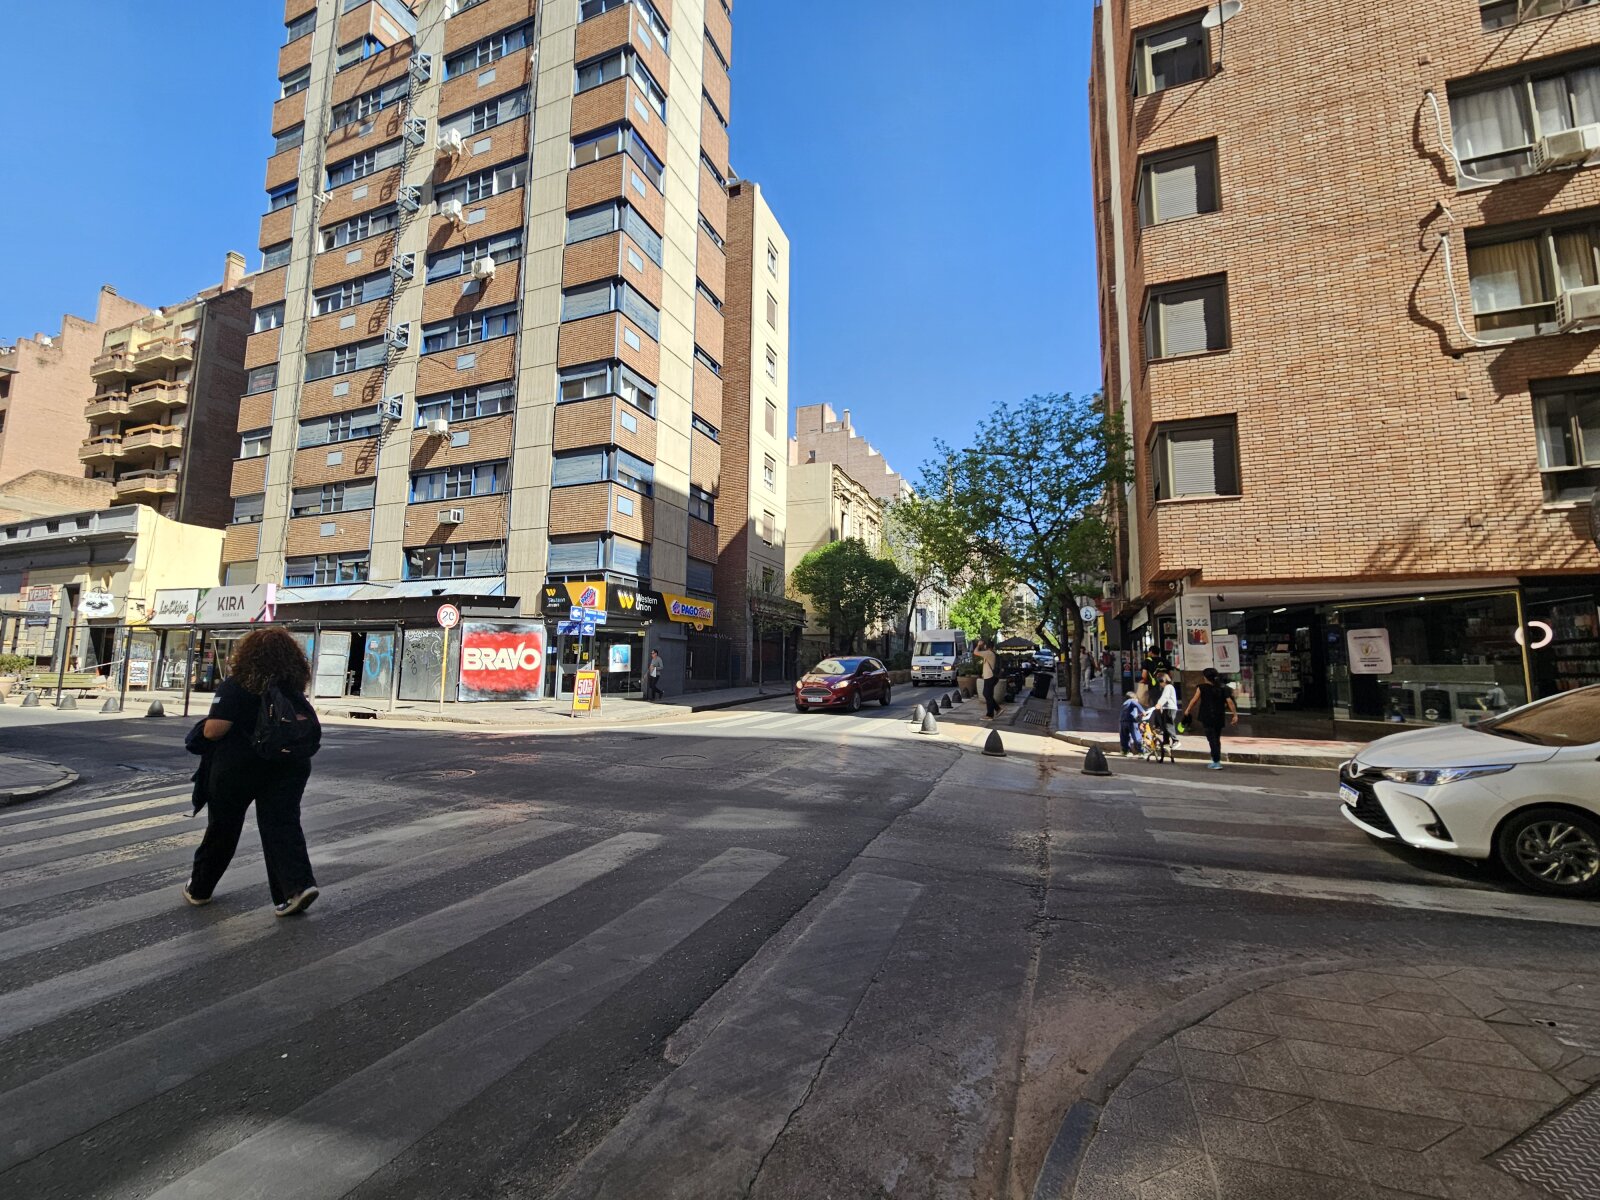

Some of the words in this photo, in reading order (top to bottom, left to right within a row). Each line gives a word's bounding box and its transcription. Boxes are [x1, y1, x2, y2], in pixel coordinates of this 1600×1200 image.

[217, 596, 245, 611] KIRA
[636, 592, 658, 605] Western
[636, 601, 652, 612] Union
[1186, 618, 1209, 627] 3X2
[463, 642, 541, 671] BRAVO
